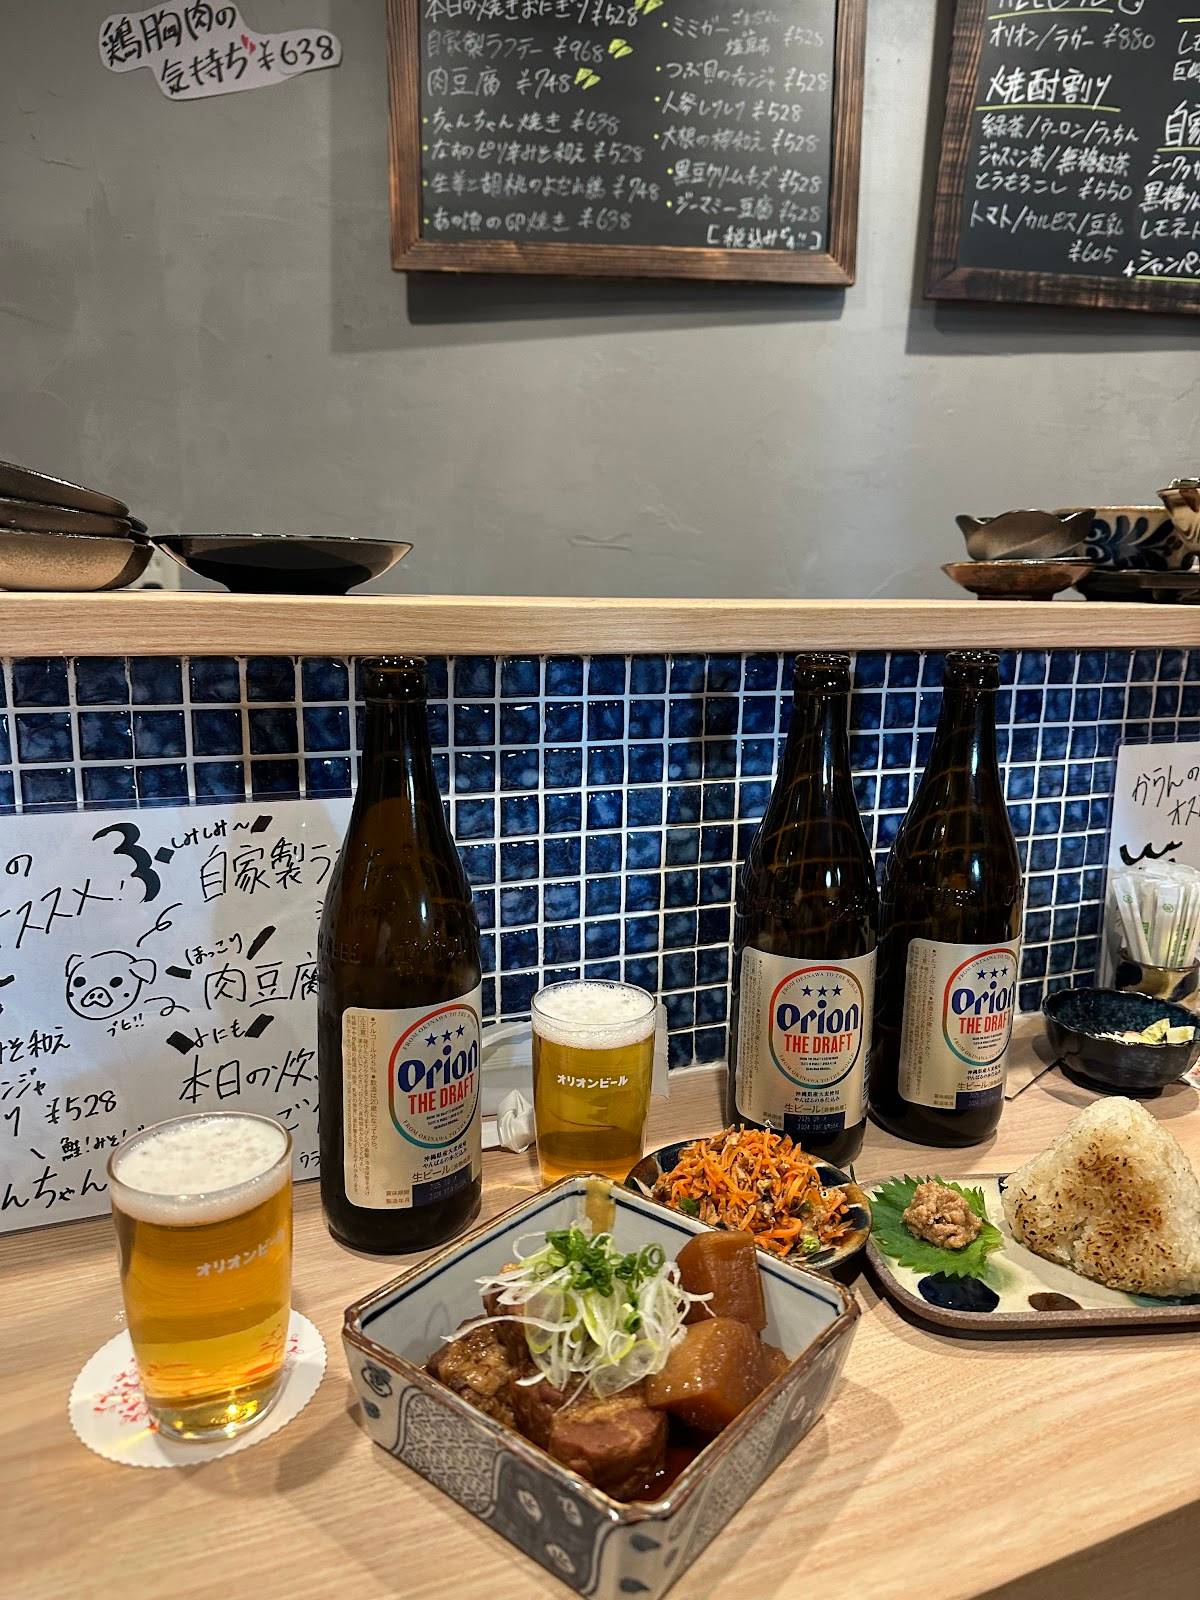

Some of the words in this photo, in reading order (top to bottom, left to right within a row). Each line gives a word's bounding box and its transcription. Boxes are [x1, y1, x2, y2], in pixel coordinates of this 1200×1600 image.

[102, 0, 237, 67] 鶏胸肉の
[427, 29, 543, 60] 自家製ラフテー
[553, 35, 605, 63] ¥968
[1102, 22, 1157, 51] ¥880
[160, 41, 248, 94] 気持ち
[258, 35, 335, 71] ¥638
[784, 66, 828, 93] ¥528
[427, 66, 502, 97] 肉豆腐
[516, 68, 573, 99] ¥748
[985, 64, 1113, 111] 焼酎割り
[570, 108, 621, 136] ¥638
[752, 99, 803, 122] ¥528
[592, 141, 644, 164] ¥528
[771, 127, 821, 155] ¥528
[778, 168, 823, 195] ¥528
[975, 171, 1068, 194] とうもろこし
[1078, 176, 1133, 202] ¥550
[577, 206, 633, 232] ¥638
[1067, 239, 1119, 264] ¥605
[1167, 795, 1200, 826] オス
[0, 878, 125, 950] ススメ!
[951, 980, 1016, 1016] Orion
[776, 999, 859, 1035] Orion
[959, 1017, 983, 1035] THE
[783, 1033, 809, 1054] THE
[812, 1032, 853, 1055] DRAFT
[179, 1047, 319, 1104] 本日の炊
[397, 1039, 478, 1093] Orion
[557, 1074, 628, 1089] オリオンビール
[44, 1089, 117, 1125] ¥528
[407, 1091, 437, 1116] THE
[440, 1072, 475, 1109] DRAFT
[412, 1165, 451, 1184] 生ビール
[196, 1227, 286, 1277] オリオンビール
